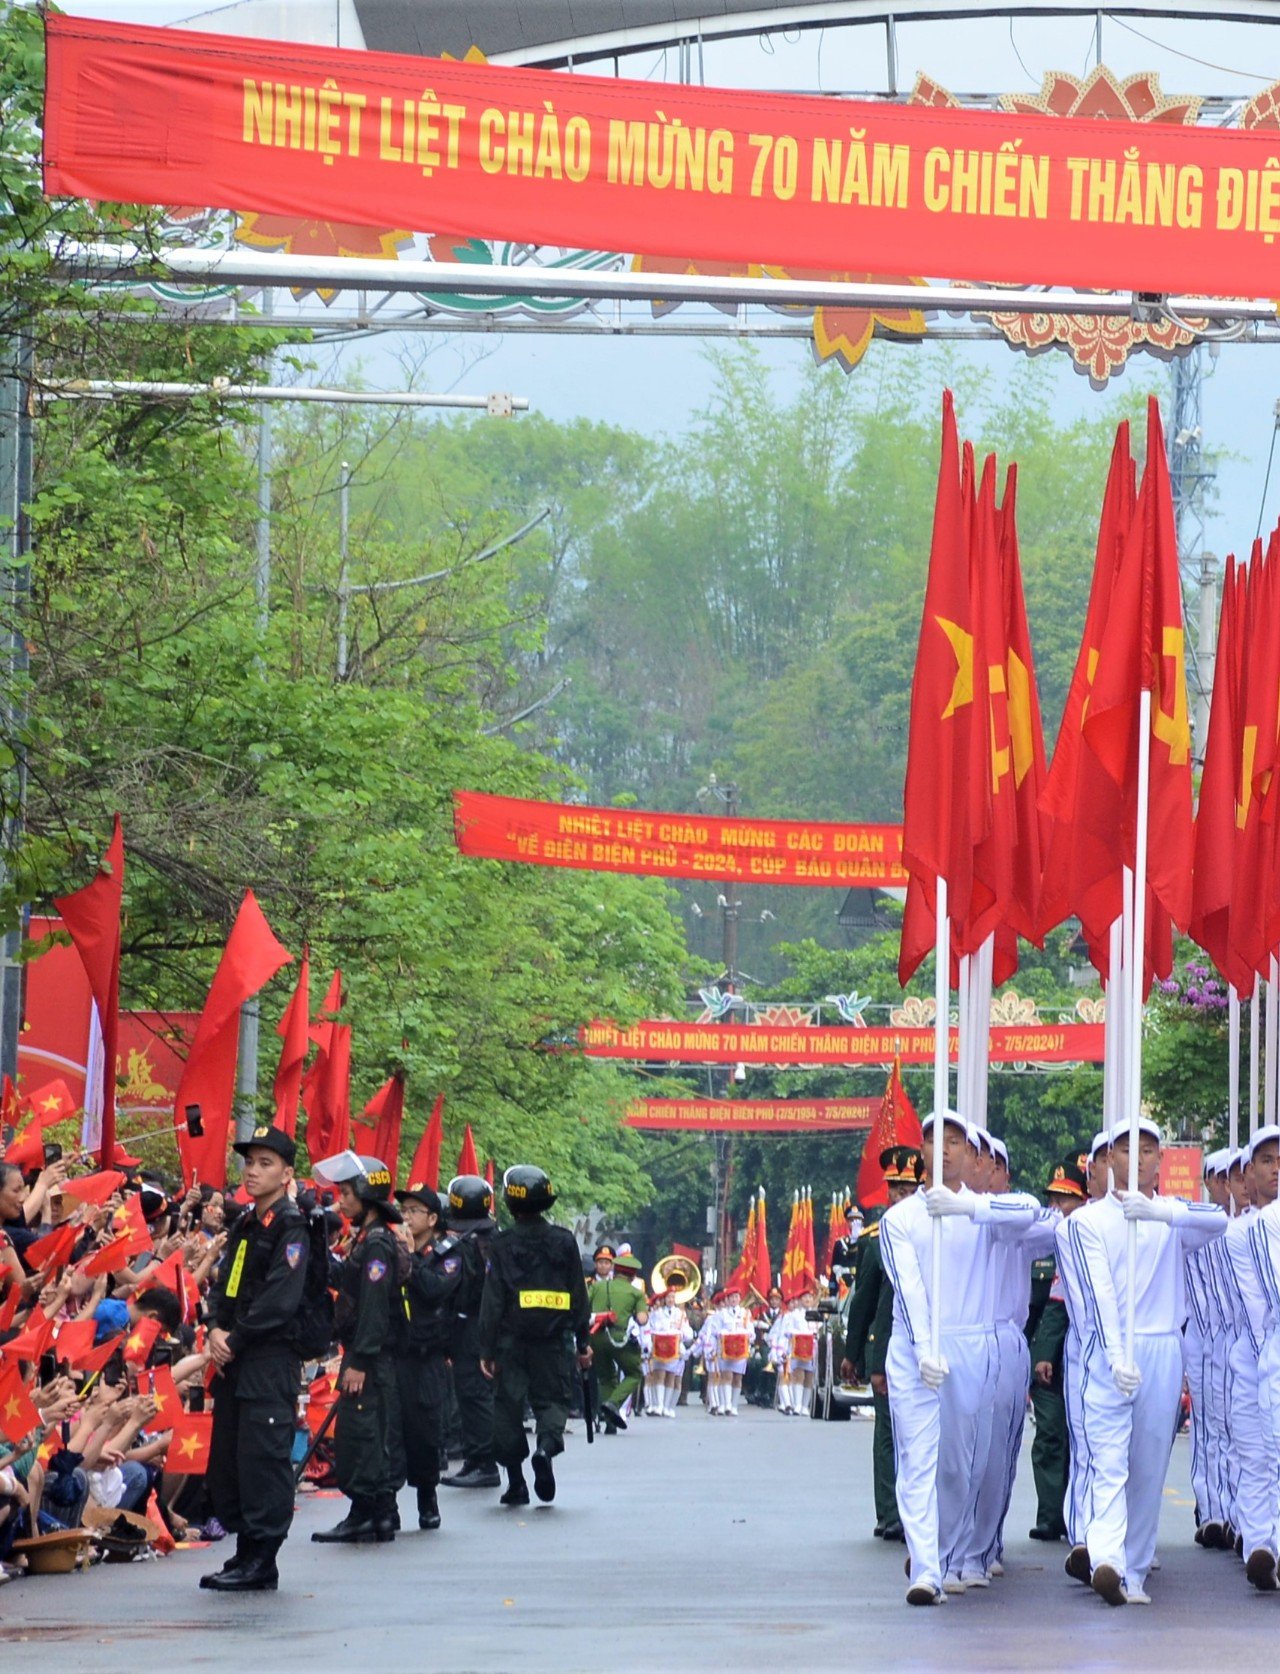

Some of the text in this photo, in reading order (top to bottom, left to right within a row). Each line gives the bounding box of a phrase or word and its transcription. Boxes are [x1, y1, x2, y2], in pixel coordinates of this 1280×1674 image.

[242, 79, 366, 166] NHIỆT
[380, 88, 467, 177] LIỆT
[479, 101, 591, 183] CHÀO
[607, 110, 734, 195] MỪNG
[748, 135, 798, 200] 70
[811, 128, 910, 209] NĂM
[924, 138, 1050, 219] CHIẾN
[1067, 146, 1203, 229] THẮNG
[559, 813, 611, 837] NHIỆT
[617, 818, 654, 843] LIỆT
[659, 823, 709, 845] CHÀO
[787, 829, 824, 851] CÁC
[834, 830, 884, 852] ĐOÀN
[650, 1029, 681, 1049] CHÀO
[723, 1034, 737, 1051] 70
[741, 1032, 768, 1052] NĂM
[882, 1034, 909, 1053] BIN
